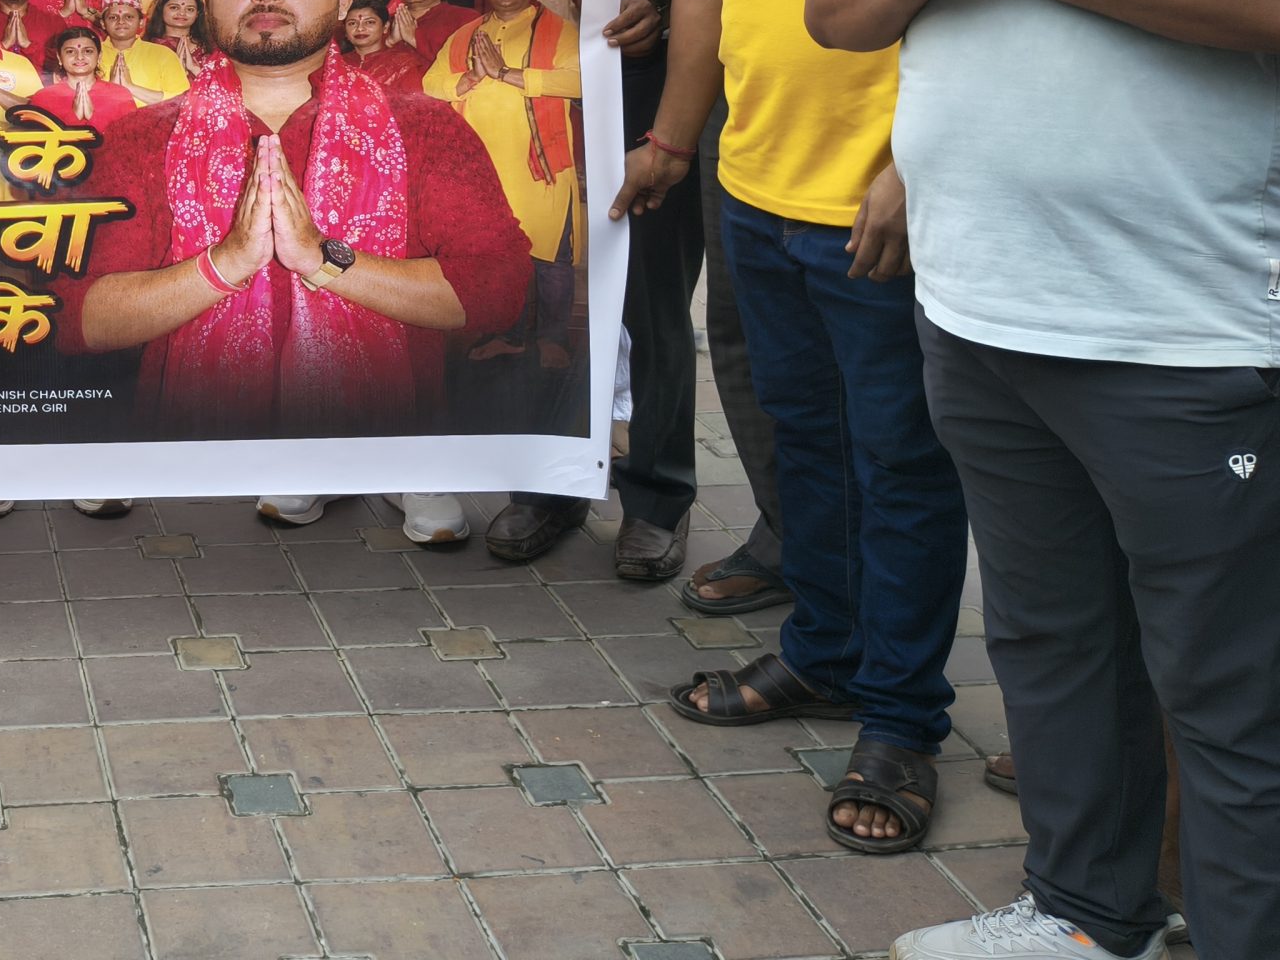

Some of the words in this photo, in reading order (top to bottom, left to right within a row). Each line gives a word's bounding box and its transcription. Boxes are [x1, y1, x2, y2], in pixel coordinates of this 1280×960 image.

[1, 109, 97, 190] के
[29, 389, 113, 400] CHAURASIYA
[41, 403, 68, 413] GIRI
